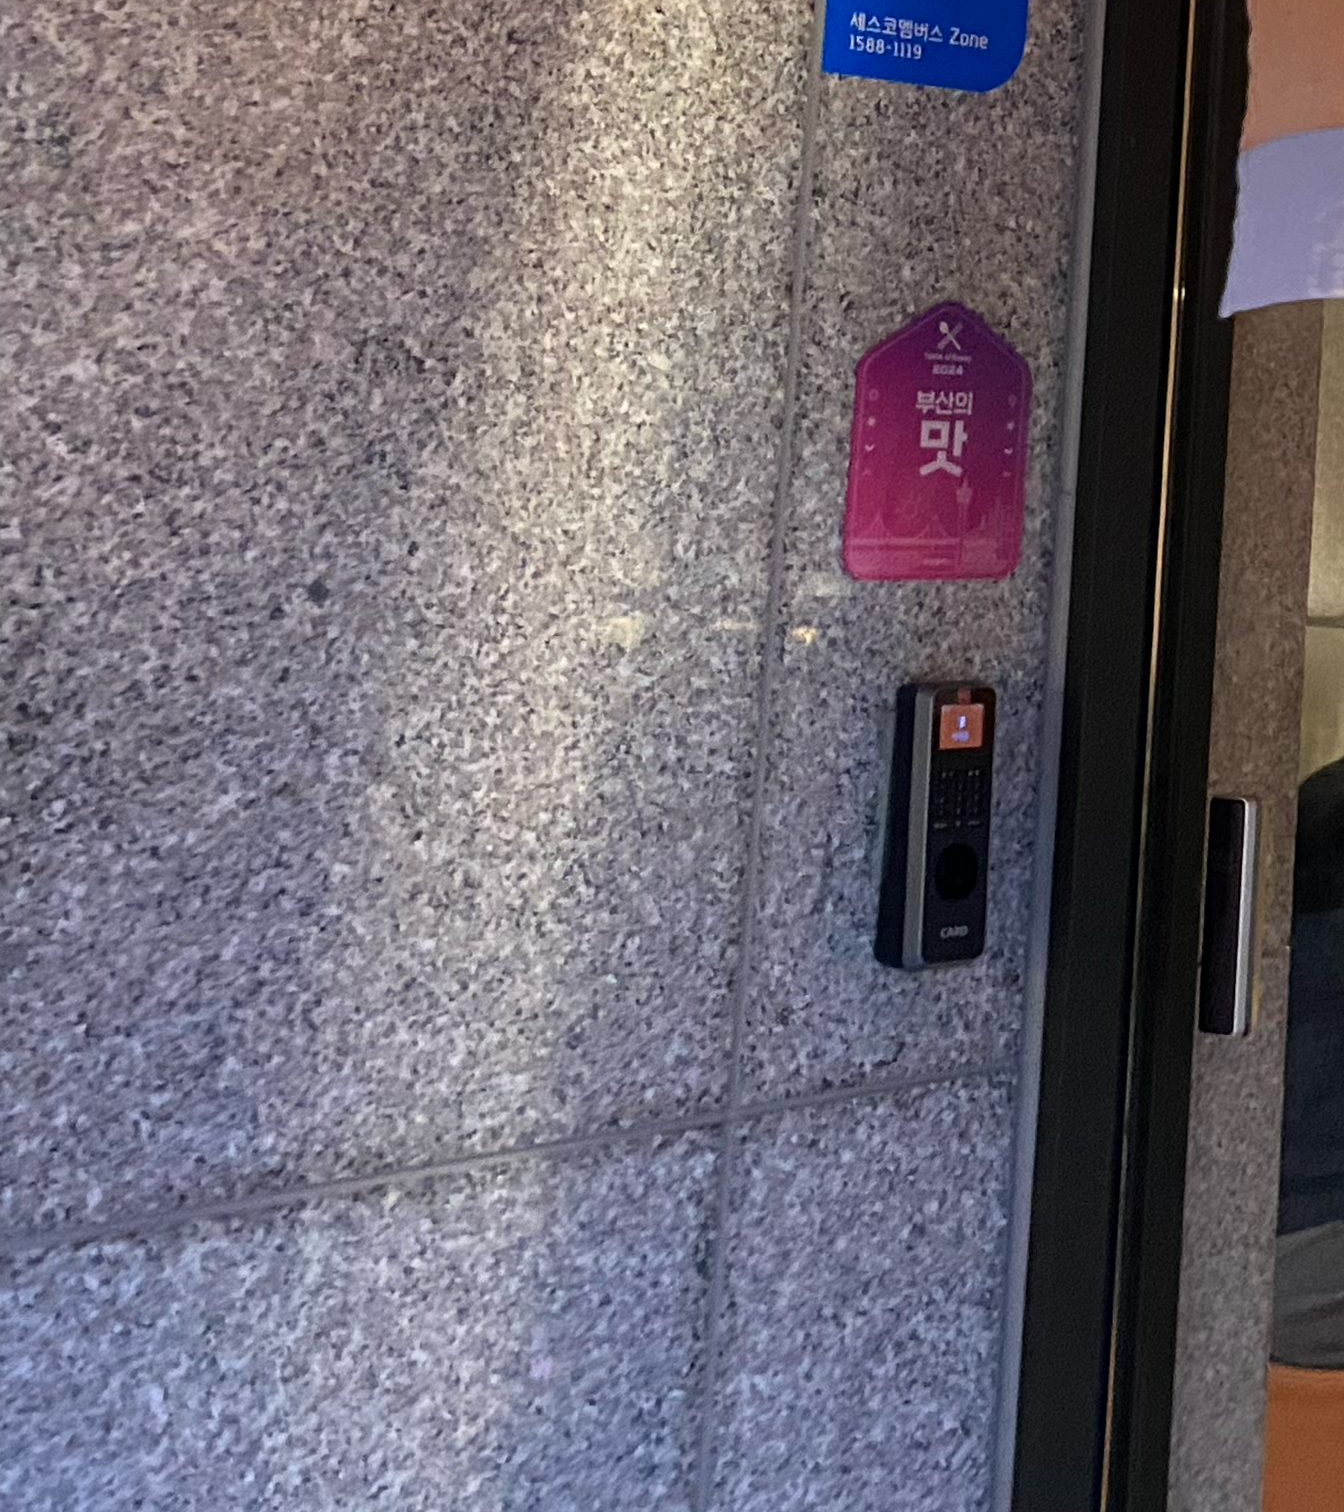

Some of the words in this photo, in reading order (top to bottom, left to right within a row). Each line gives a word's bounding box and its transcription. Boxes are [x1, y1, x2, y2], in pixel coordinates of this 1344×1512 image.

[850, 12, 943, 42] 세스코멤버스
[949, 28, 988, 49] Zone
[849, 35, 922, 59] 1588-1119
[916, 390, 973, 415] 부산의
[919, 420, 968, 477] 맛
